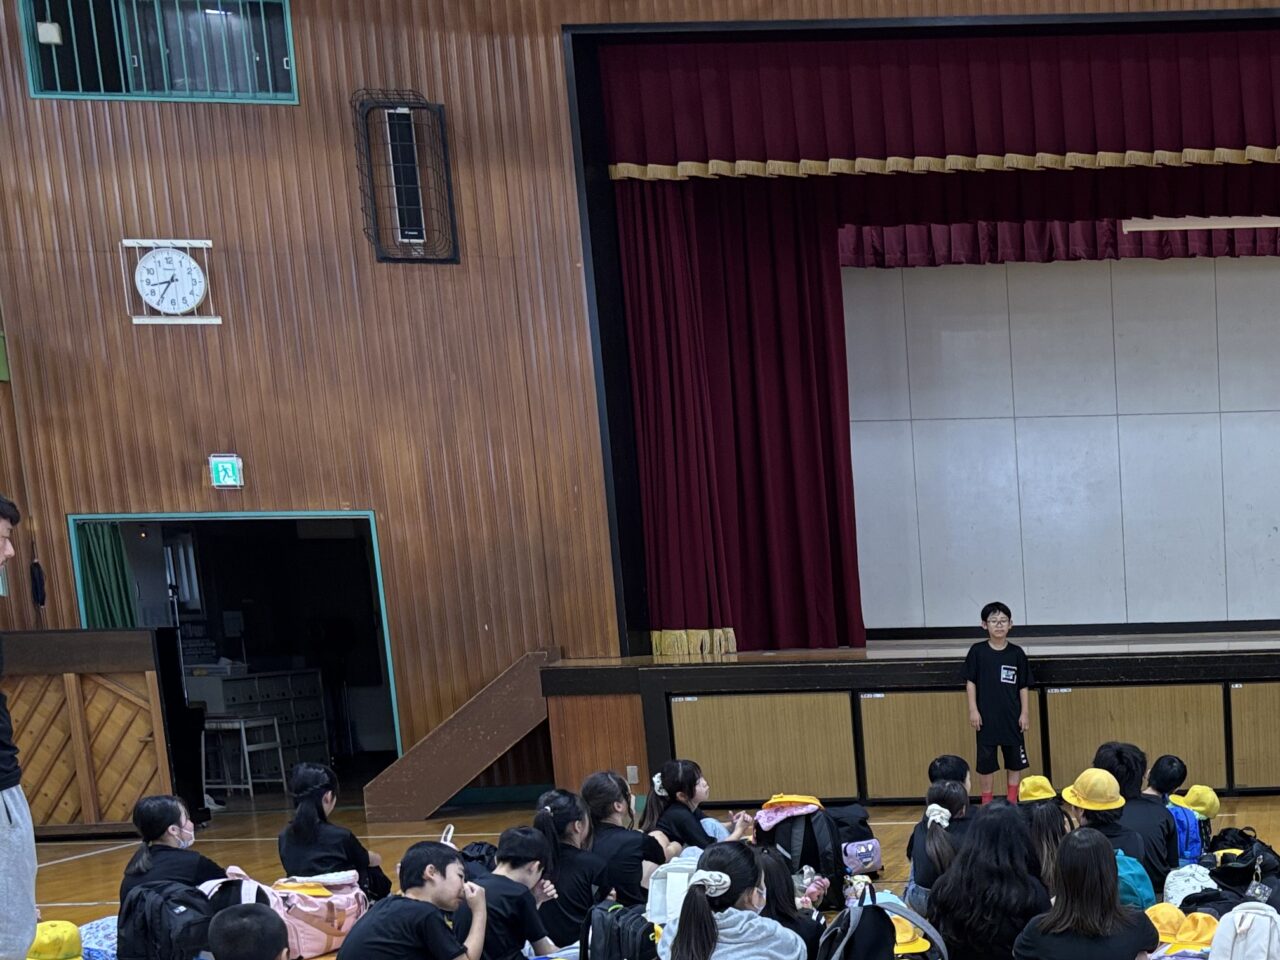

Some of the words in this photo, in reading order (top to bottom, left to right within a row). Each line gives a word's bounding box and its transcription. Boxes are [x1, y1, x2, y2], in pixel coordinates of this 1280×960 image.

[164, 256, 173, 264] 12
[146, 267, 155, 275] 10
[187, 267, 193, 275] 2
[145, 278, 151, 286] 9
[191, 278, 198, 286] 3
[170, 298, 177, 306] 6
[181, 296, 188, 304] 5
